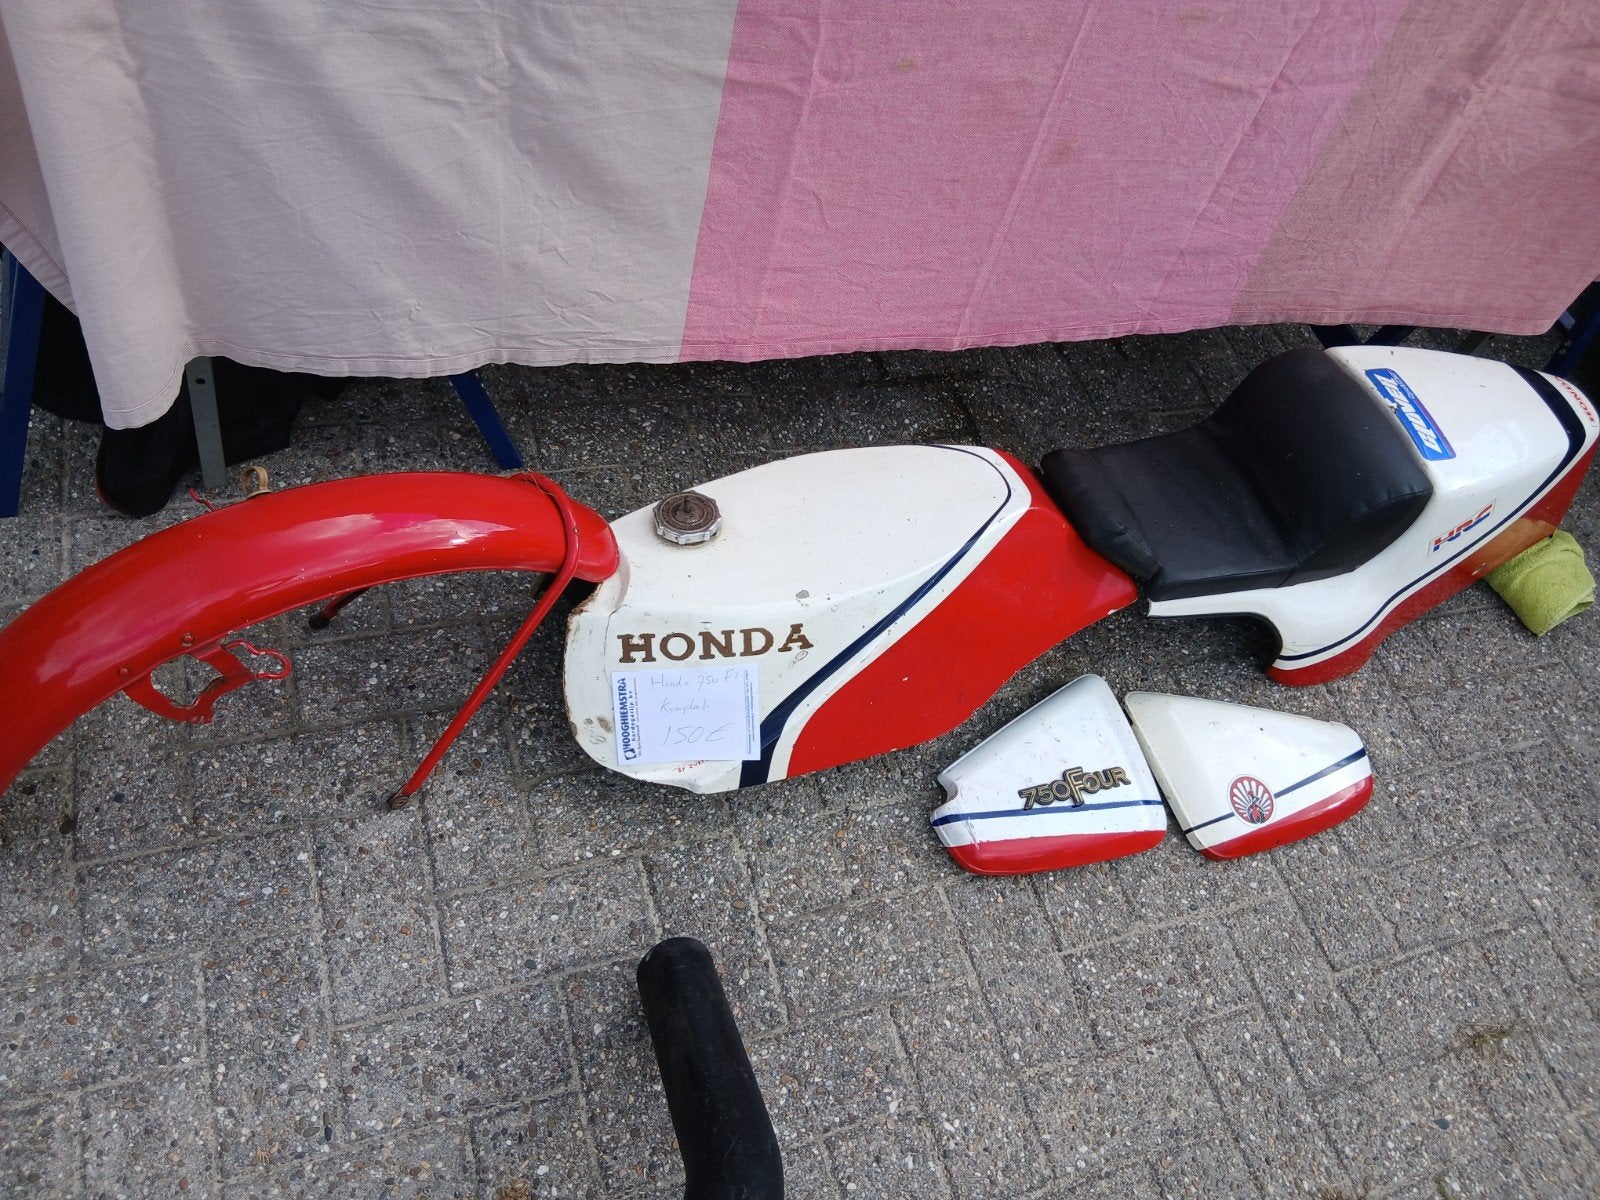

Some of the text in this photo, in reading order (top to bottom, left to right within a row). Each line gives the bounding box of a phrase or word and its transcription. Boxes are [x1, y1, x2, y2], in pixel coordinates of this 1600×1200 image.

[1433, 504, 1492, 552] HRC
[617, 623, 814, 663] HONDA
[651, 673, 690, 690] Honda
[617, 677, 631, 753] HOOGHIEMSTRA
